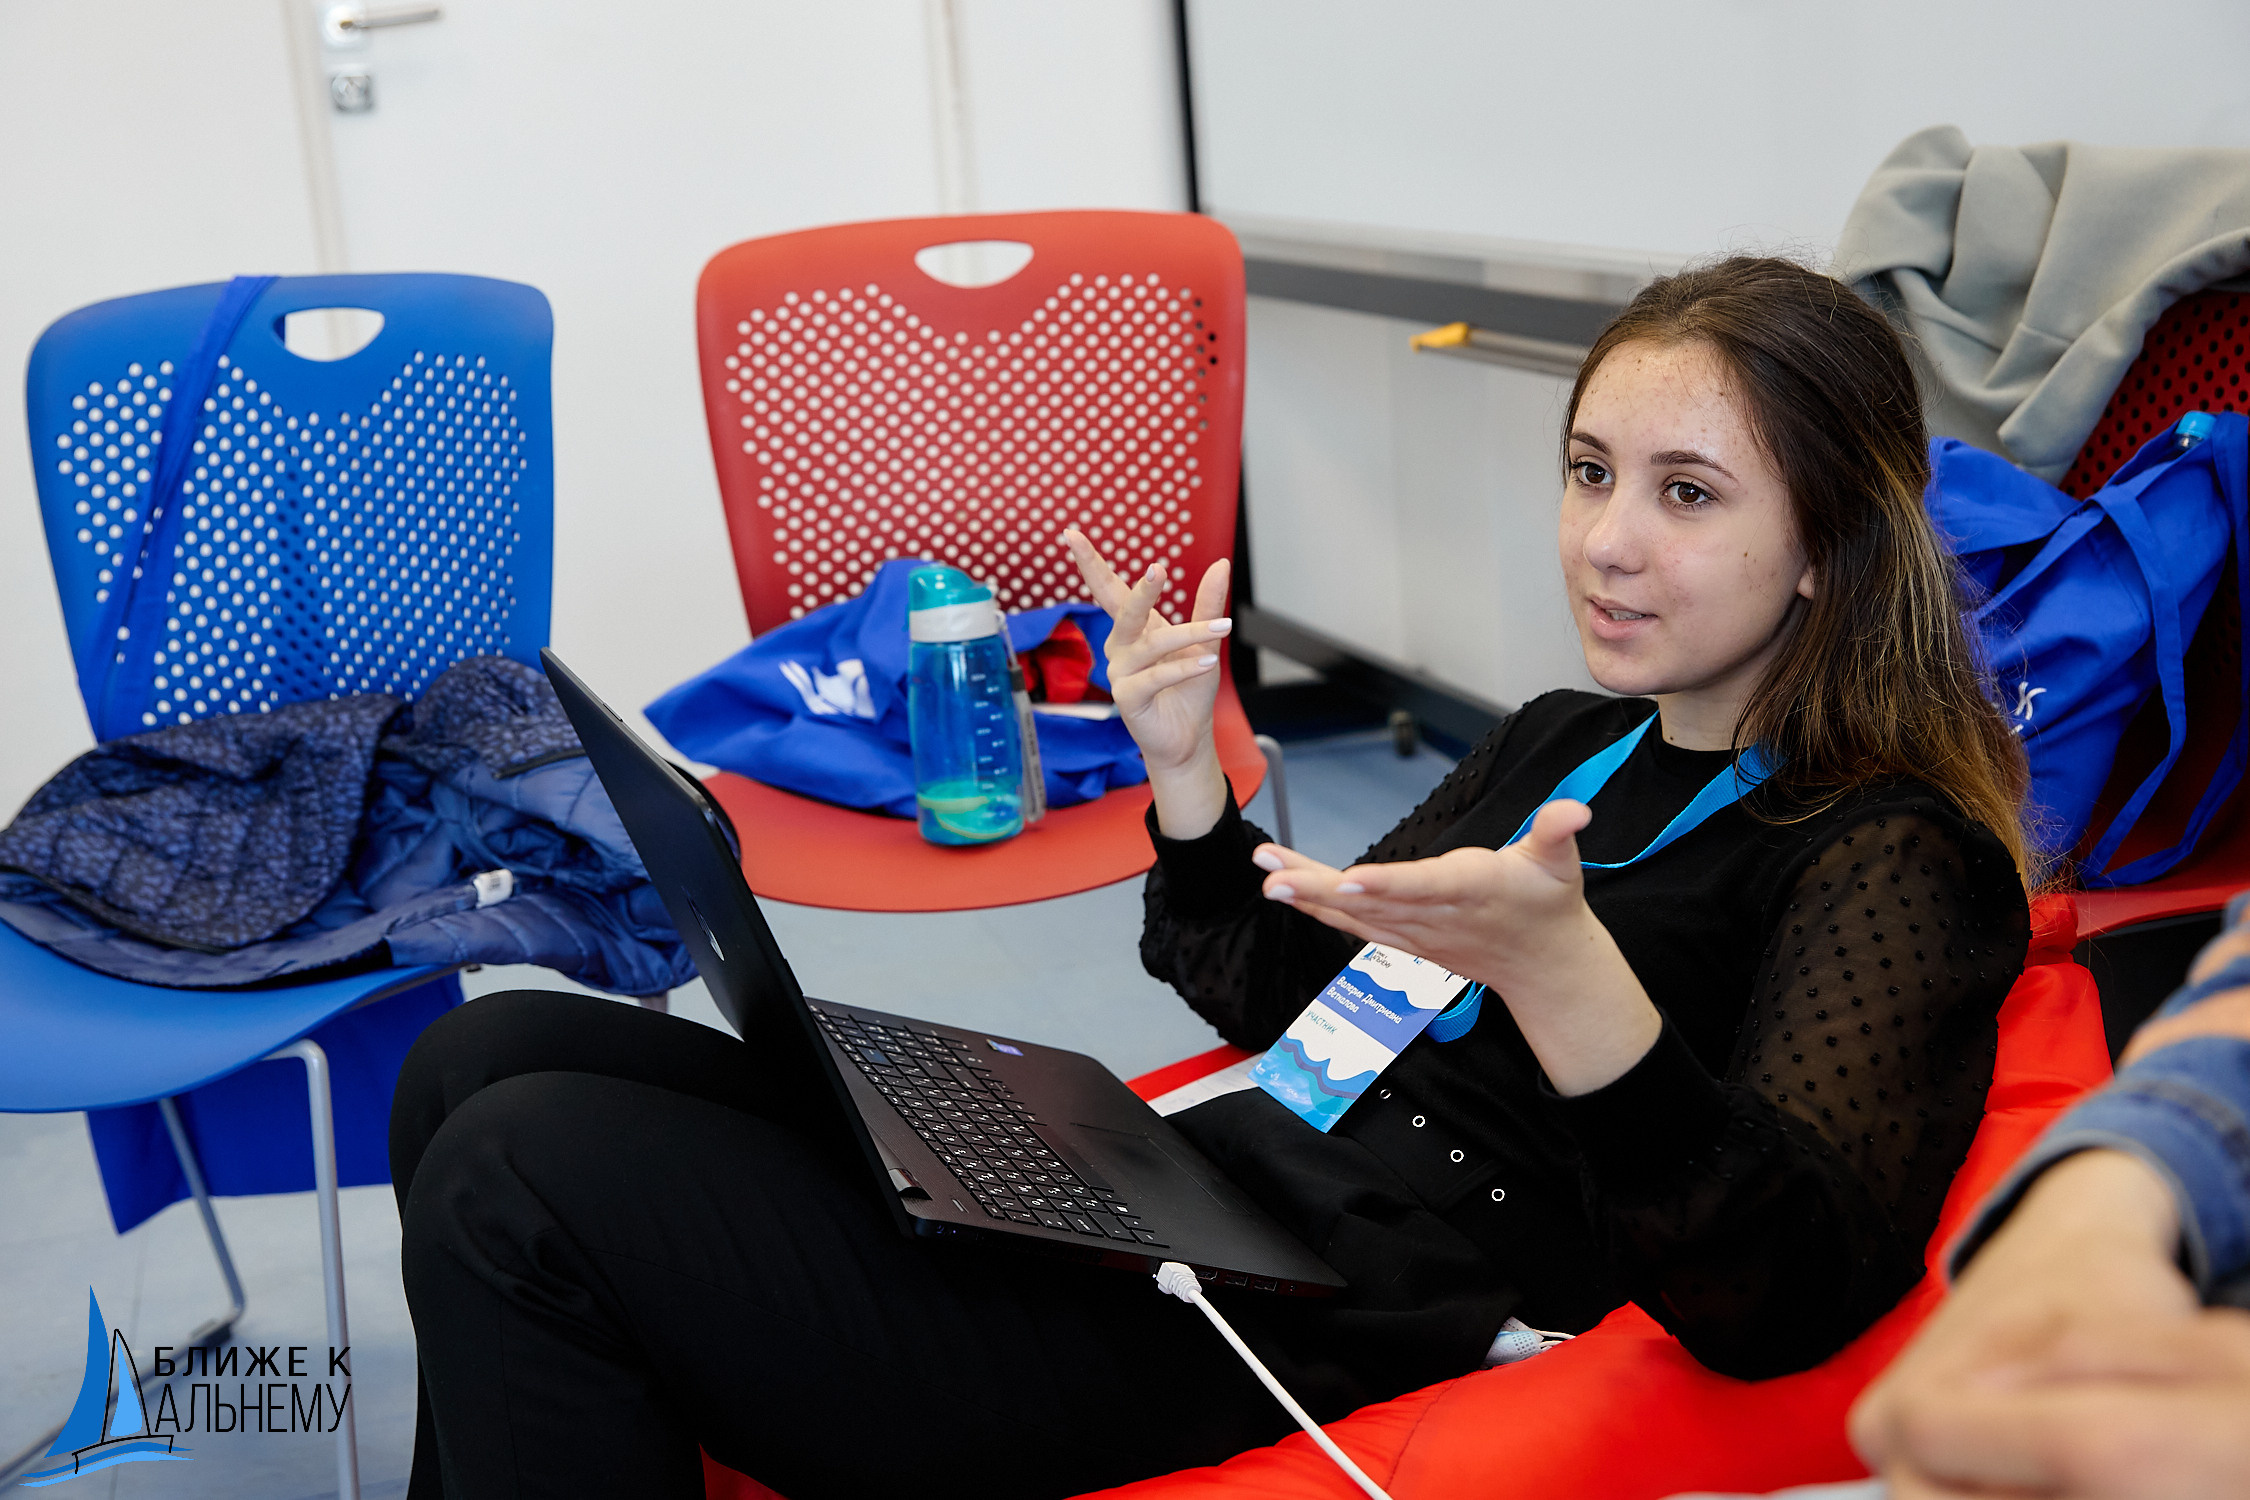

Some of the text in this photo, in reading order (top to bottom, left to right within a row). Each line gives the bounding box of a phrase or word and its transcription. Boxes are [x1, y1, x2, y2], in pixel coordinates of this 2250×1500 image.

[1336, 975, 1403, 1025] Валерия Дмитриевна
[1305, 1010, 1337, 1035] УЧАСТНИК
